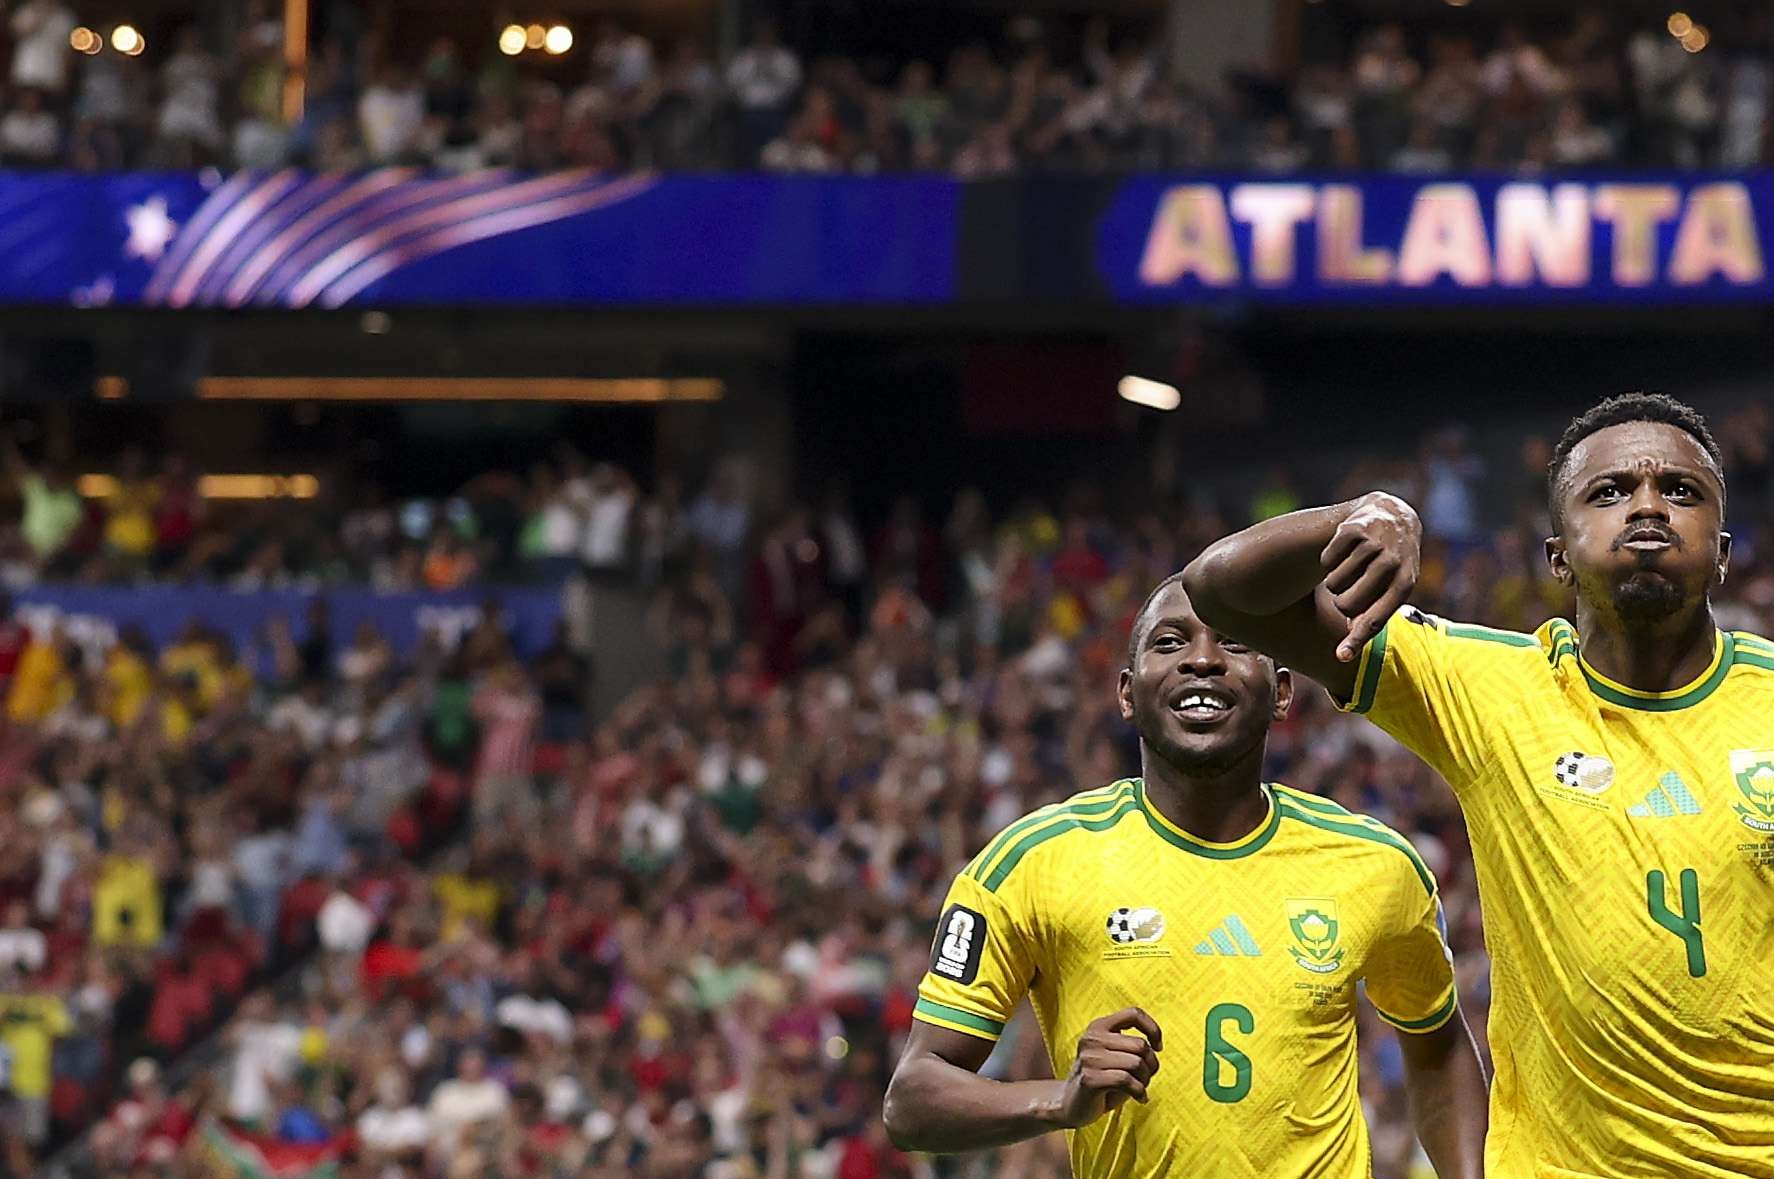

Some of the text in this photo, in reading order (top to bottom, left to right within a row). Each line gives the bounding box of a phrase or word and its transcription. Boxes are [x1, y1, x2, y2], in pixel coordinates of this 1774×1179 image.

[1139, 182, 1766, 288] ATLANTA
[1647, 868, 1707, 978] 4
[1203, 1003, 1254, 1103] 6
